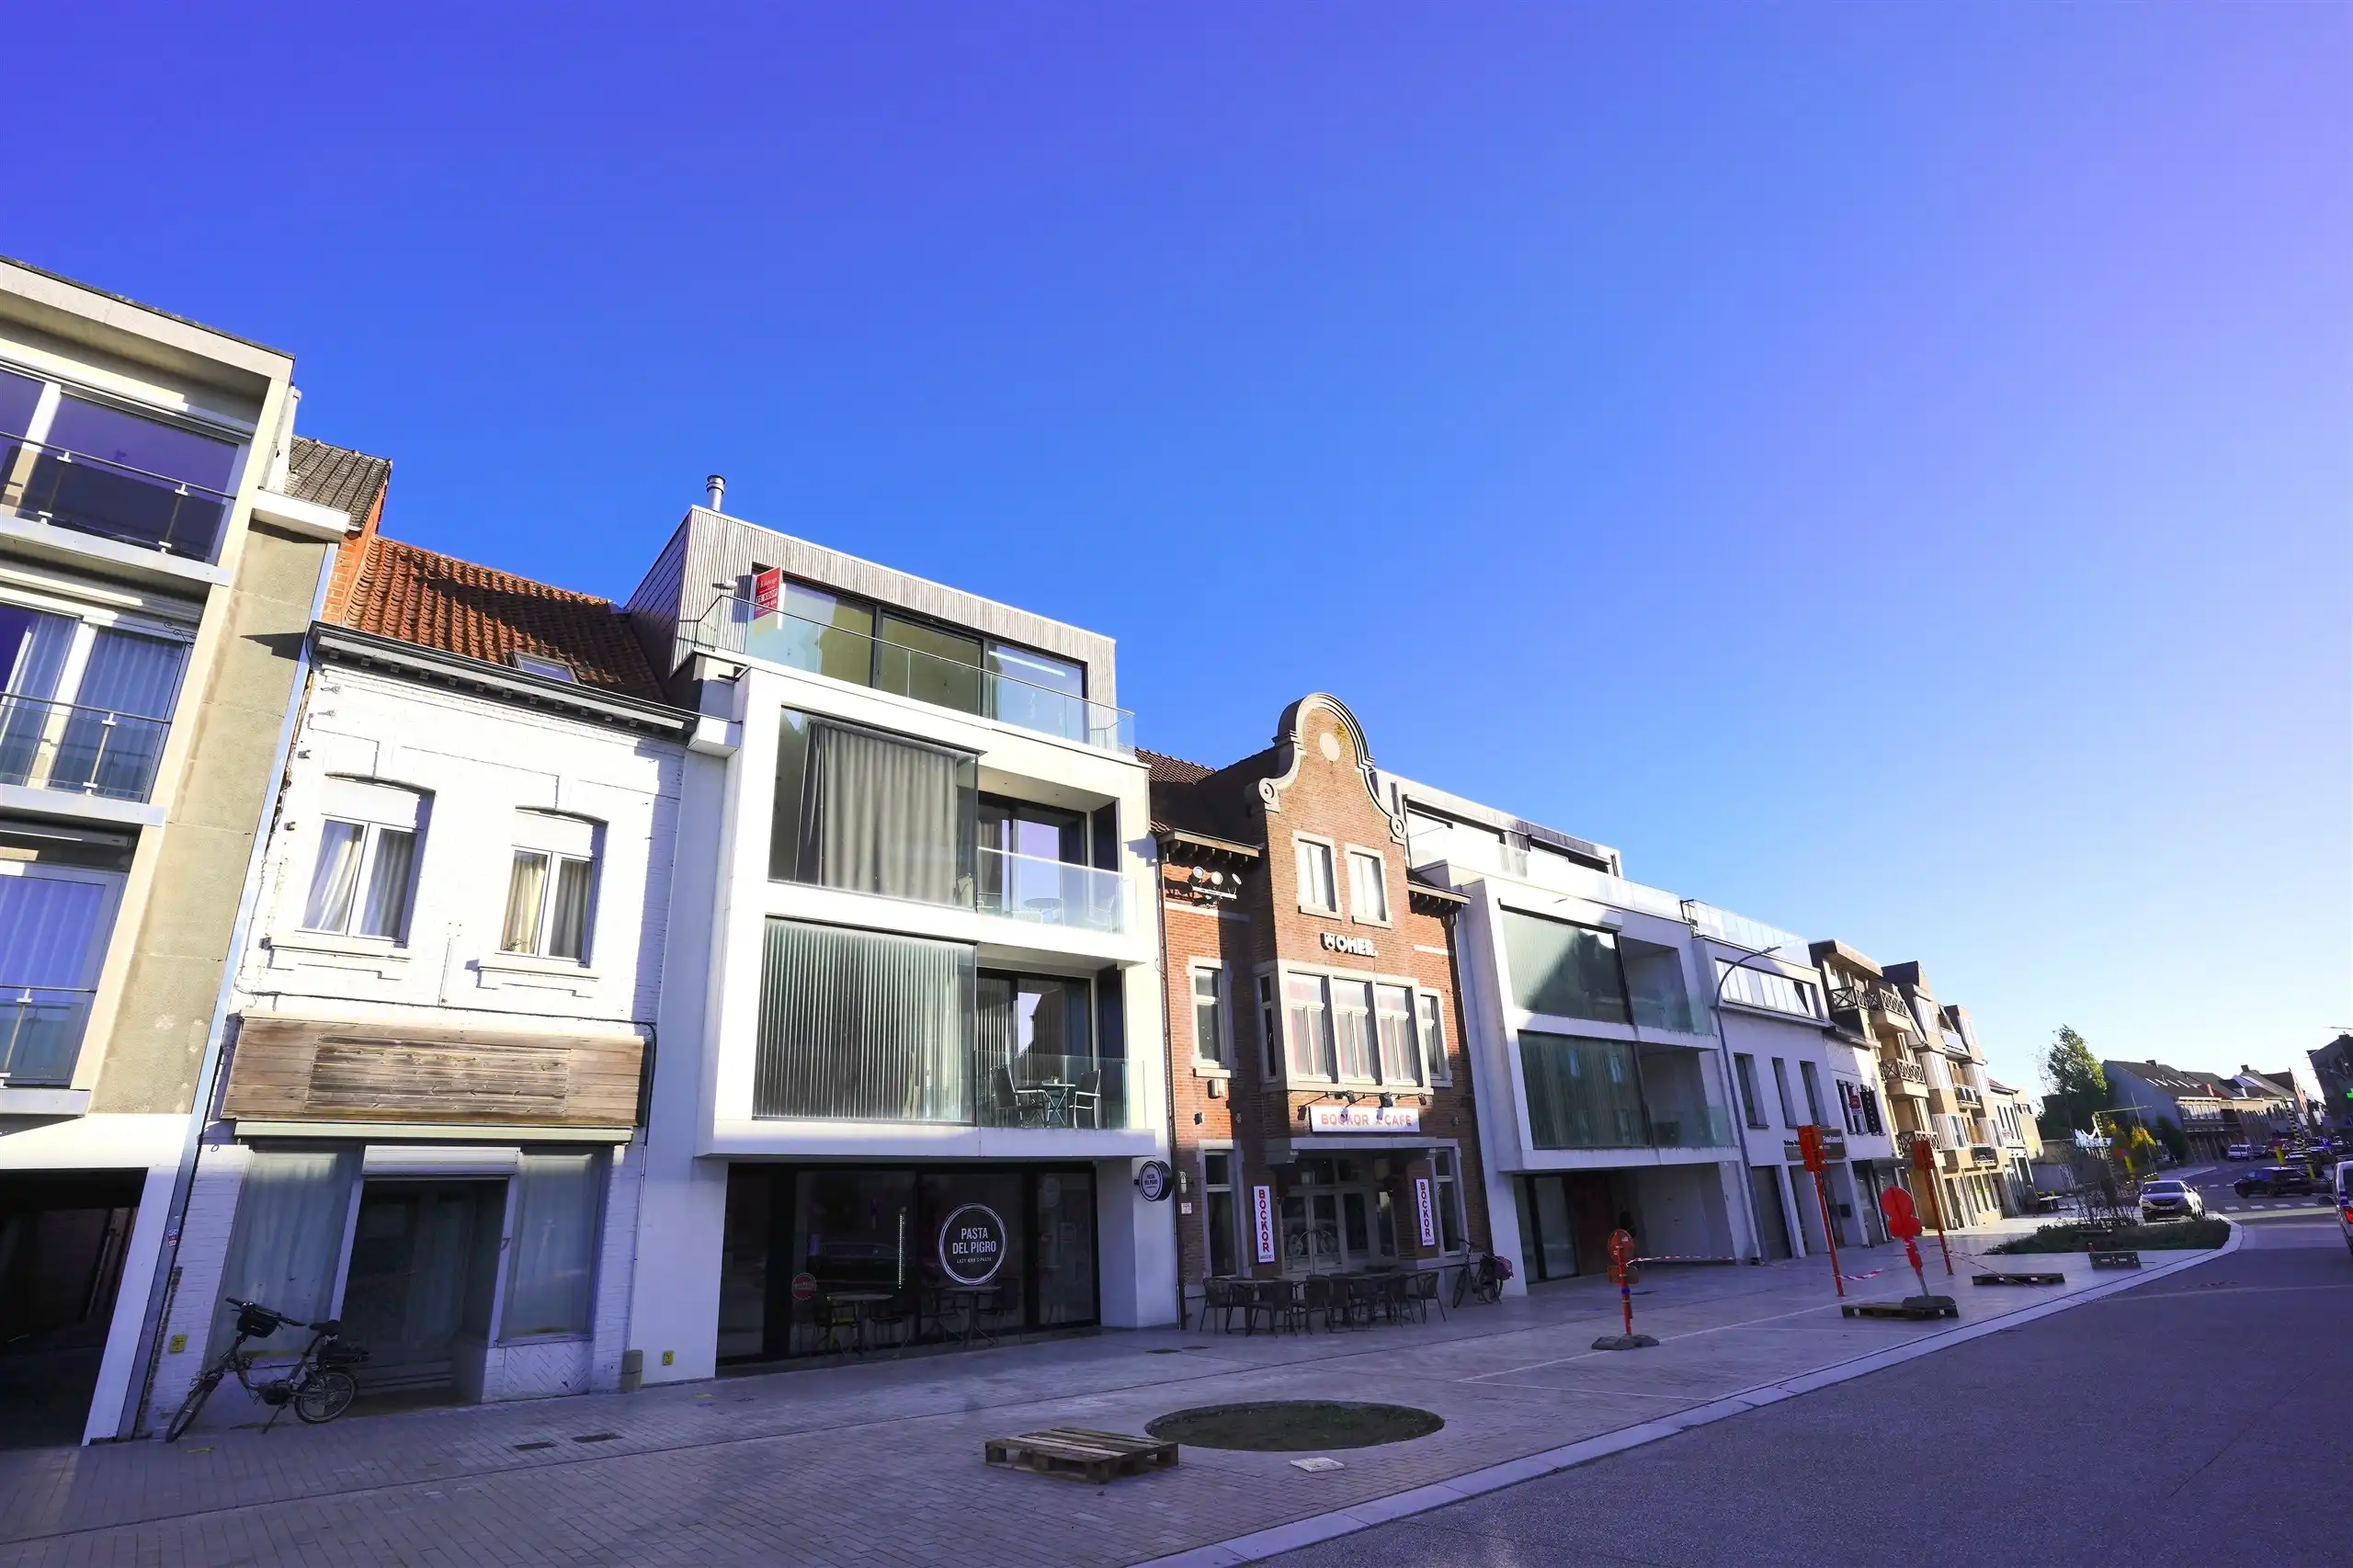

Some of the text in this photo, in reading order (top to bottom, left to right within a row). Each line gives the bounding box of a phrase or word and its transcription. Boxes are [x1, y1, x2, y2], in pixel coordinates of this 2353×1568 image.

[1258, 1188, 1270, 1253] BOCKOR
[1420, 1181, 1431, 1238] BOCKOR
[952, 1240, 997, 1255] DEL PIGRO
[961, 1227, 988, 1240] PASTA
